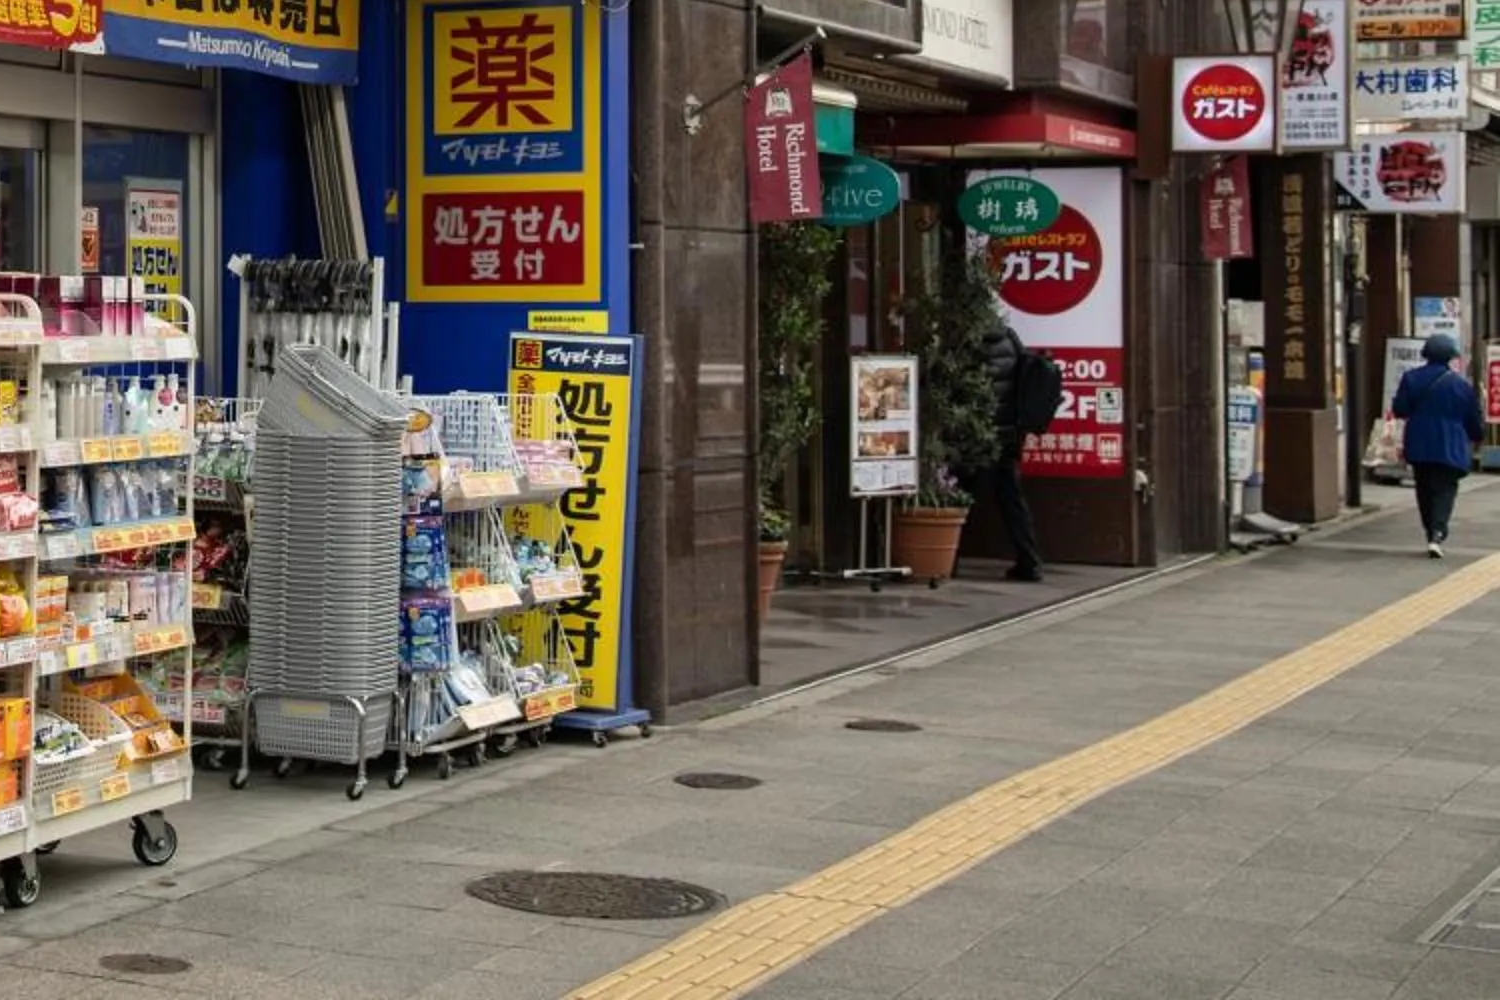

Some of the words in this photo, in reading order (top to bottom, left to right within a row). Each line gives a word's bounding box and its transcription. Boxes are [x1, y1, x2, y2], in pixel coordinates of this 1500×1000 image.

[451, 13, 555, 127] 薬
[1355, 67, 1459, 95] 大村歯科
[1193, 98, 1256, 119] ガスト
[441, 137, 564, 166] マツモトキヨシ
[756, 125, 779, 173] Hotel
[784, 121, 810, 215] Richmond
[433, 206, 581, 246] 処方せん
[470, 249, 546, 280] 受付
[1001, 249, 1092, 282] ガスト
[1054, 389, 1097, 419] 2F
